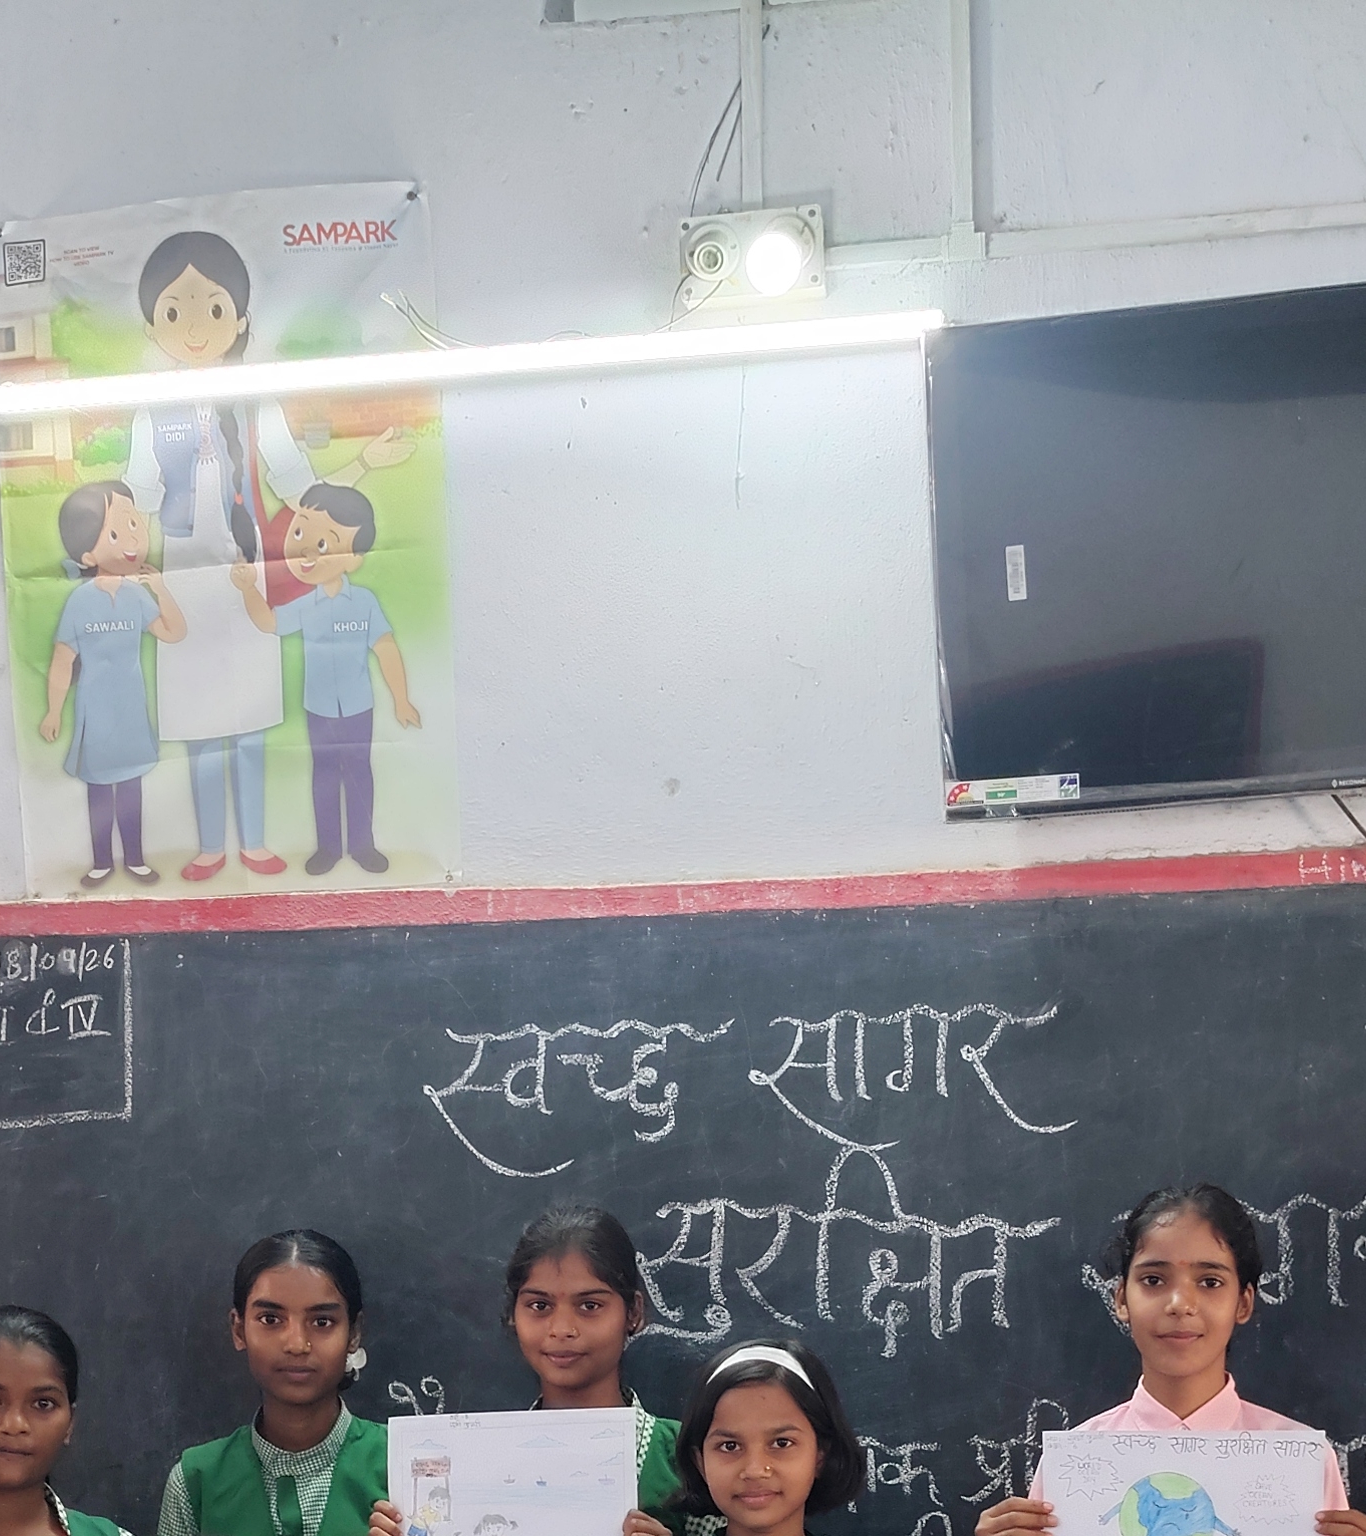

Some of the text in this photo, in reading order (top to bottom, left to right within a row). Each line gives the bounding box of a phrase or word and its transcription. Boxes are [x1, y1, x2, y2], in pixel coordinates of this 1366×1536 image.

[283, 219, 398, 246] SAMPARK
[165, 432, 185, 442] DIDI
[84, 621, 135, 634] SAWAALI
[333, 621, 369, 633] KHOJI
[748, 1002, 1079, 1152] सागर
[1110, 1433, 1161, 1455] स्वच्छ
[1168, 1436, 1209, 1455] सागर
[1215, 1431, 1268, 1460] सुरक्षित
[1272, 1439, 1325, 1461] सागर
